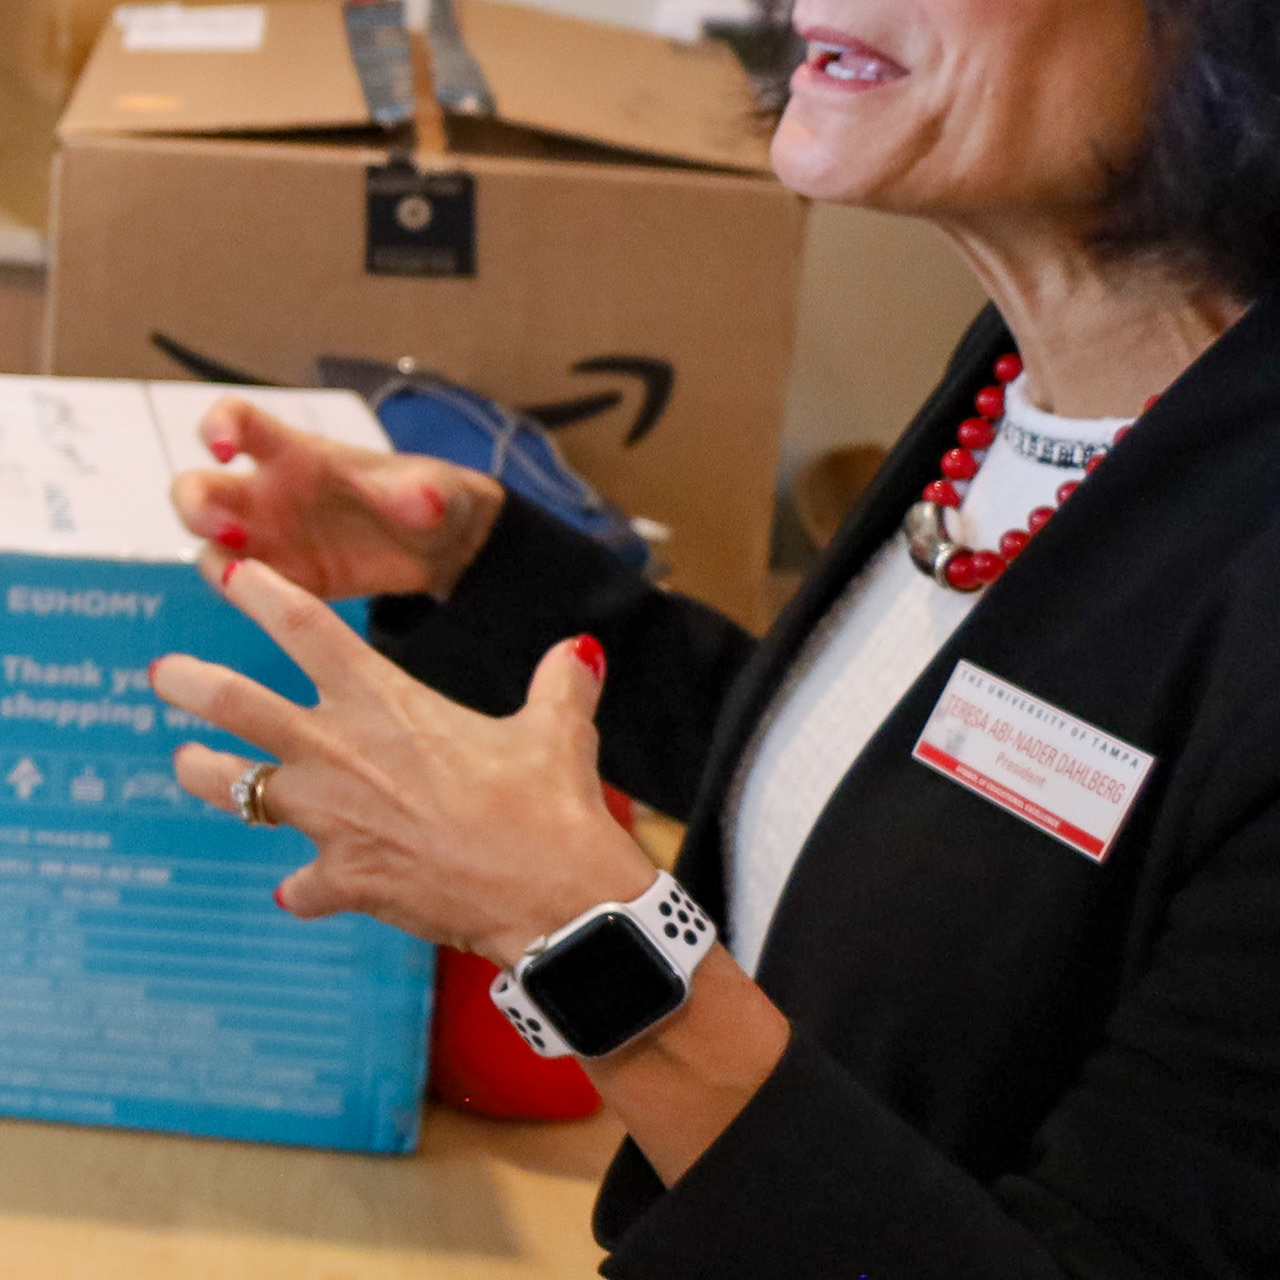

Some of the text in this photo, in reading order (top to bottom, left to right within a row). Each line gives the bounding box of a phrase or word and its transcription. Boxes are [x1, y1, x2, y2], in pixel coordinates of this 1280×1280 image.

[7, 586, 163, 617] EUHOMY
[2, 654, 152, 695] Thank yo
[0, 692, 154, 733] shopping
[961, 670, 1139, 769] THE UNIVERSITY OF TAMPA
[945, 694, 1127, 804] TERESA ABI-NADER DAHLBERG
[995, 752, 1046, 788] President
